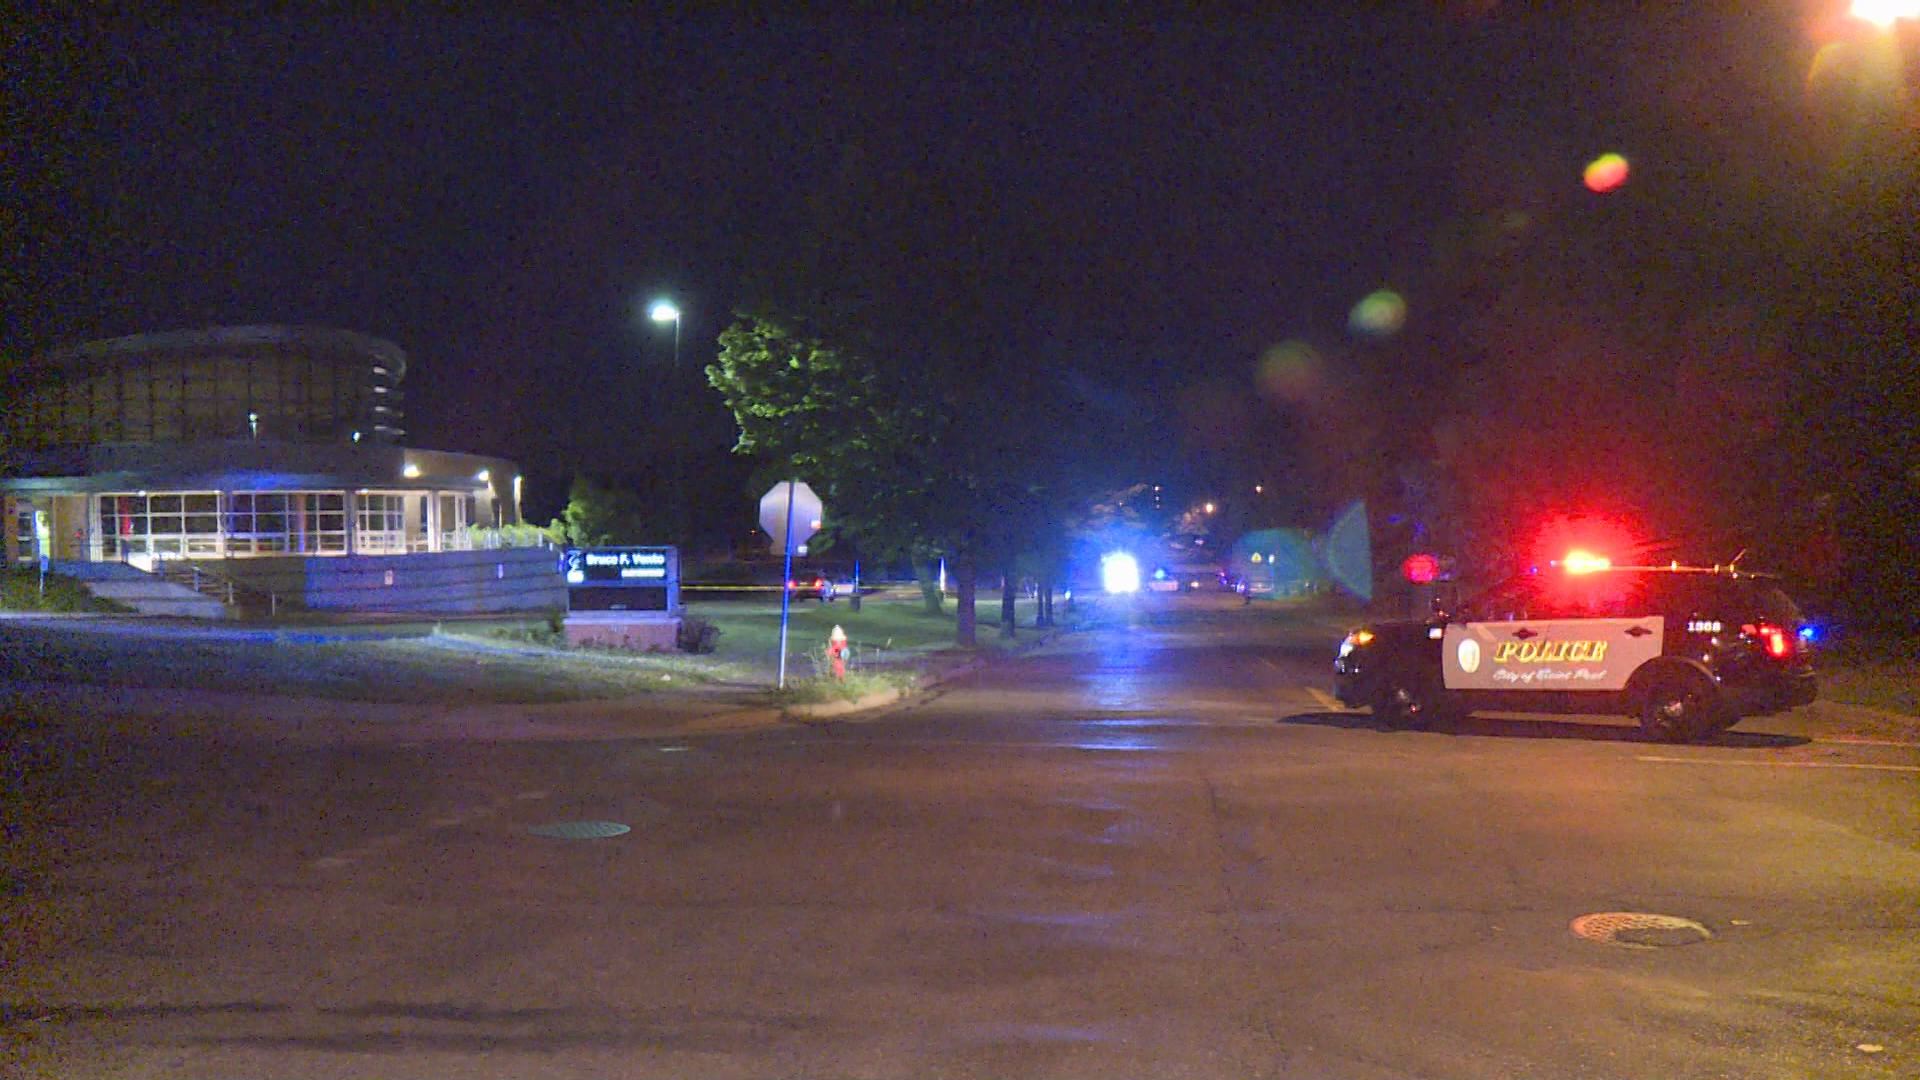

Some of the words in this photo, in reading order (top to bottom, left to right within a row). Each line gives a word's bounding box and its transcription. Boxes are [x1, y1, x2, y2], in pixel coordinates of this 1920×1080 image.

[1494, 640, 1608, 663] POLICE
[1493, 669, 1519, 683] City
[1521, 671, 1535, 683] of
